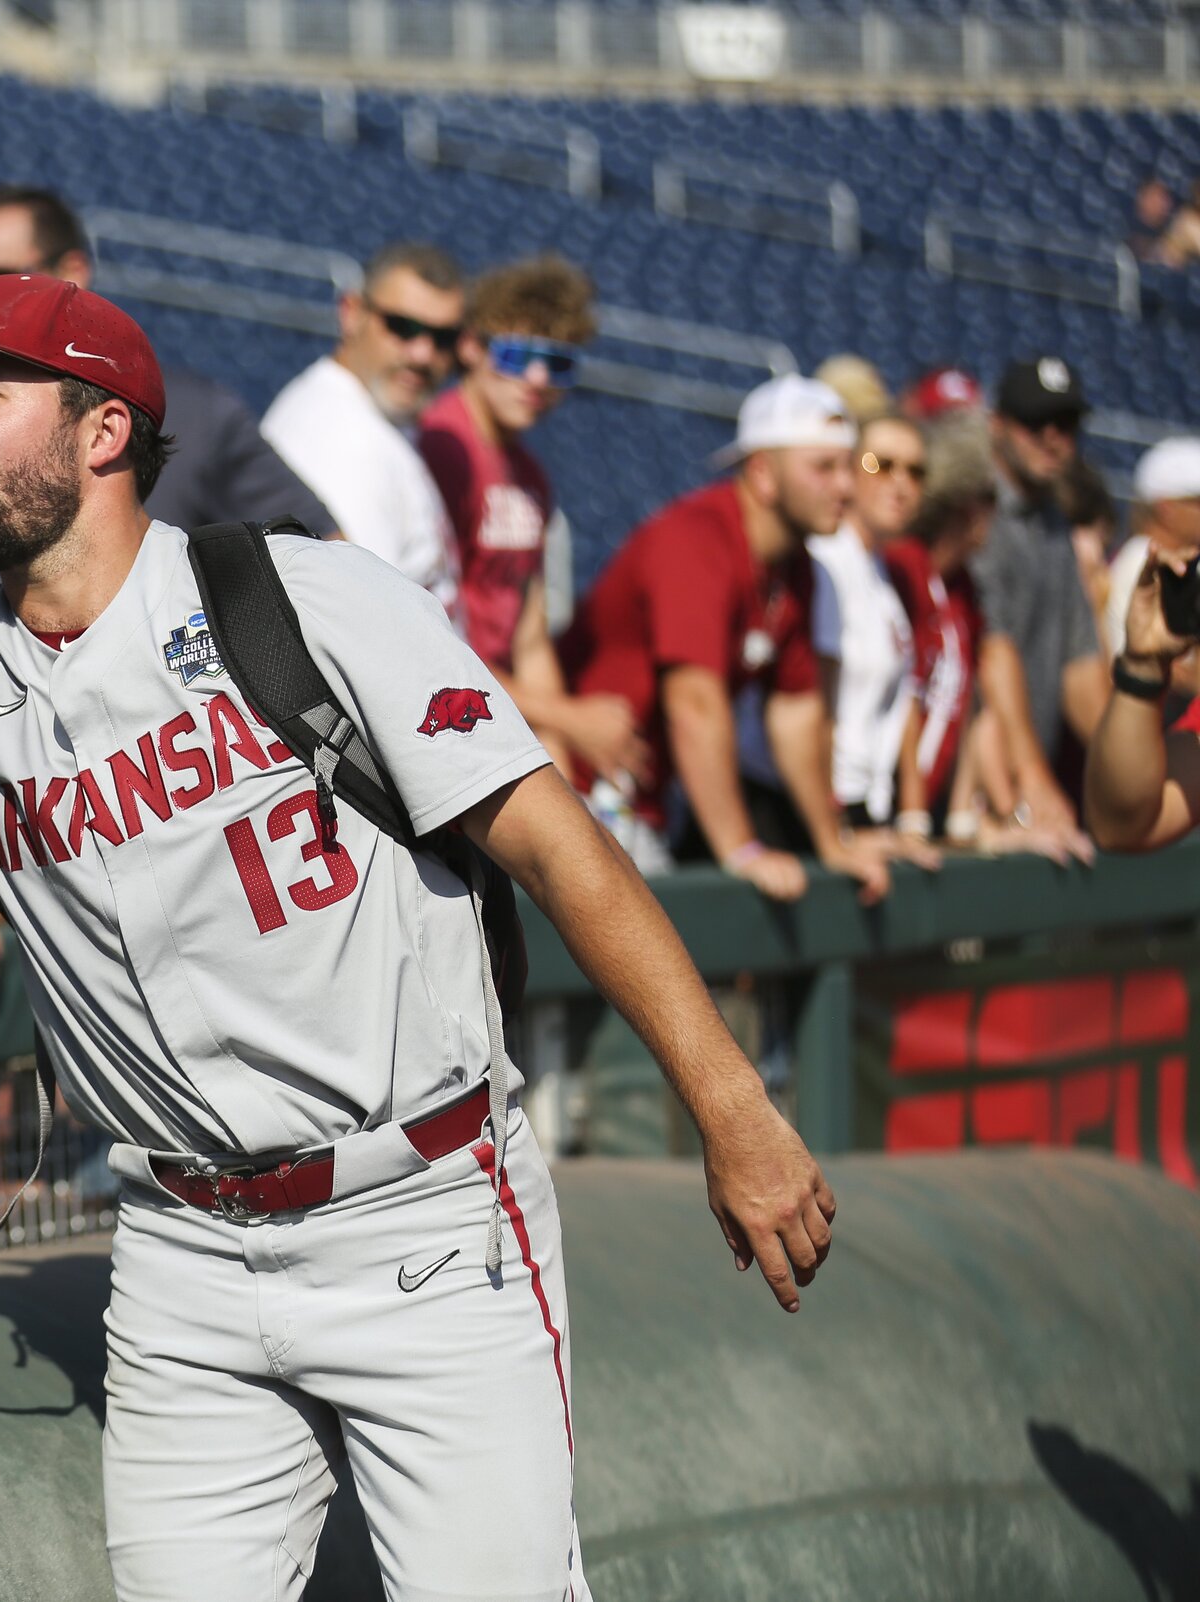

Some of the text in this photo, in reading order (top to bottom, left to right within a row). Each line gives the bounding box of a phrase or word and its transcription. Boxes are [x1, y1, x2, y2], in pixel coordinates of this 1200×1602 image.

[182, 637, 215, 655] COLLE
[169, 649, 208, 670] WORLD
[222, 789, 359, 936] 13
